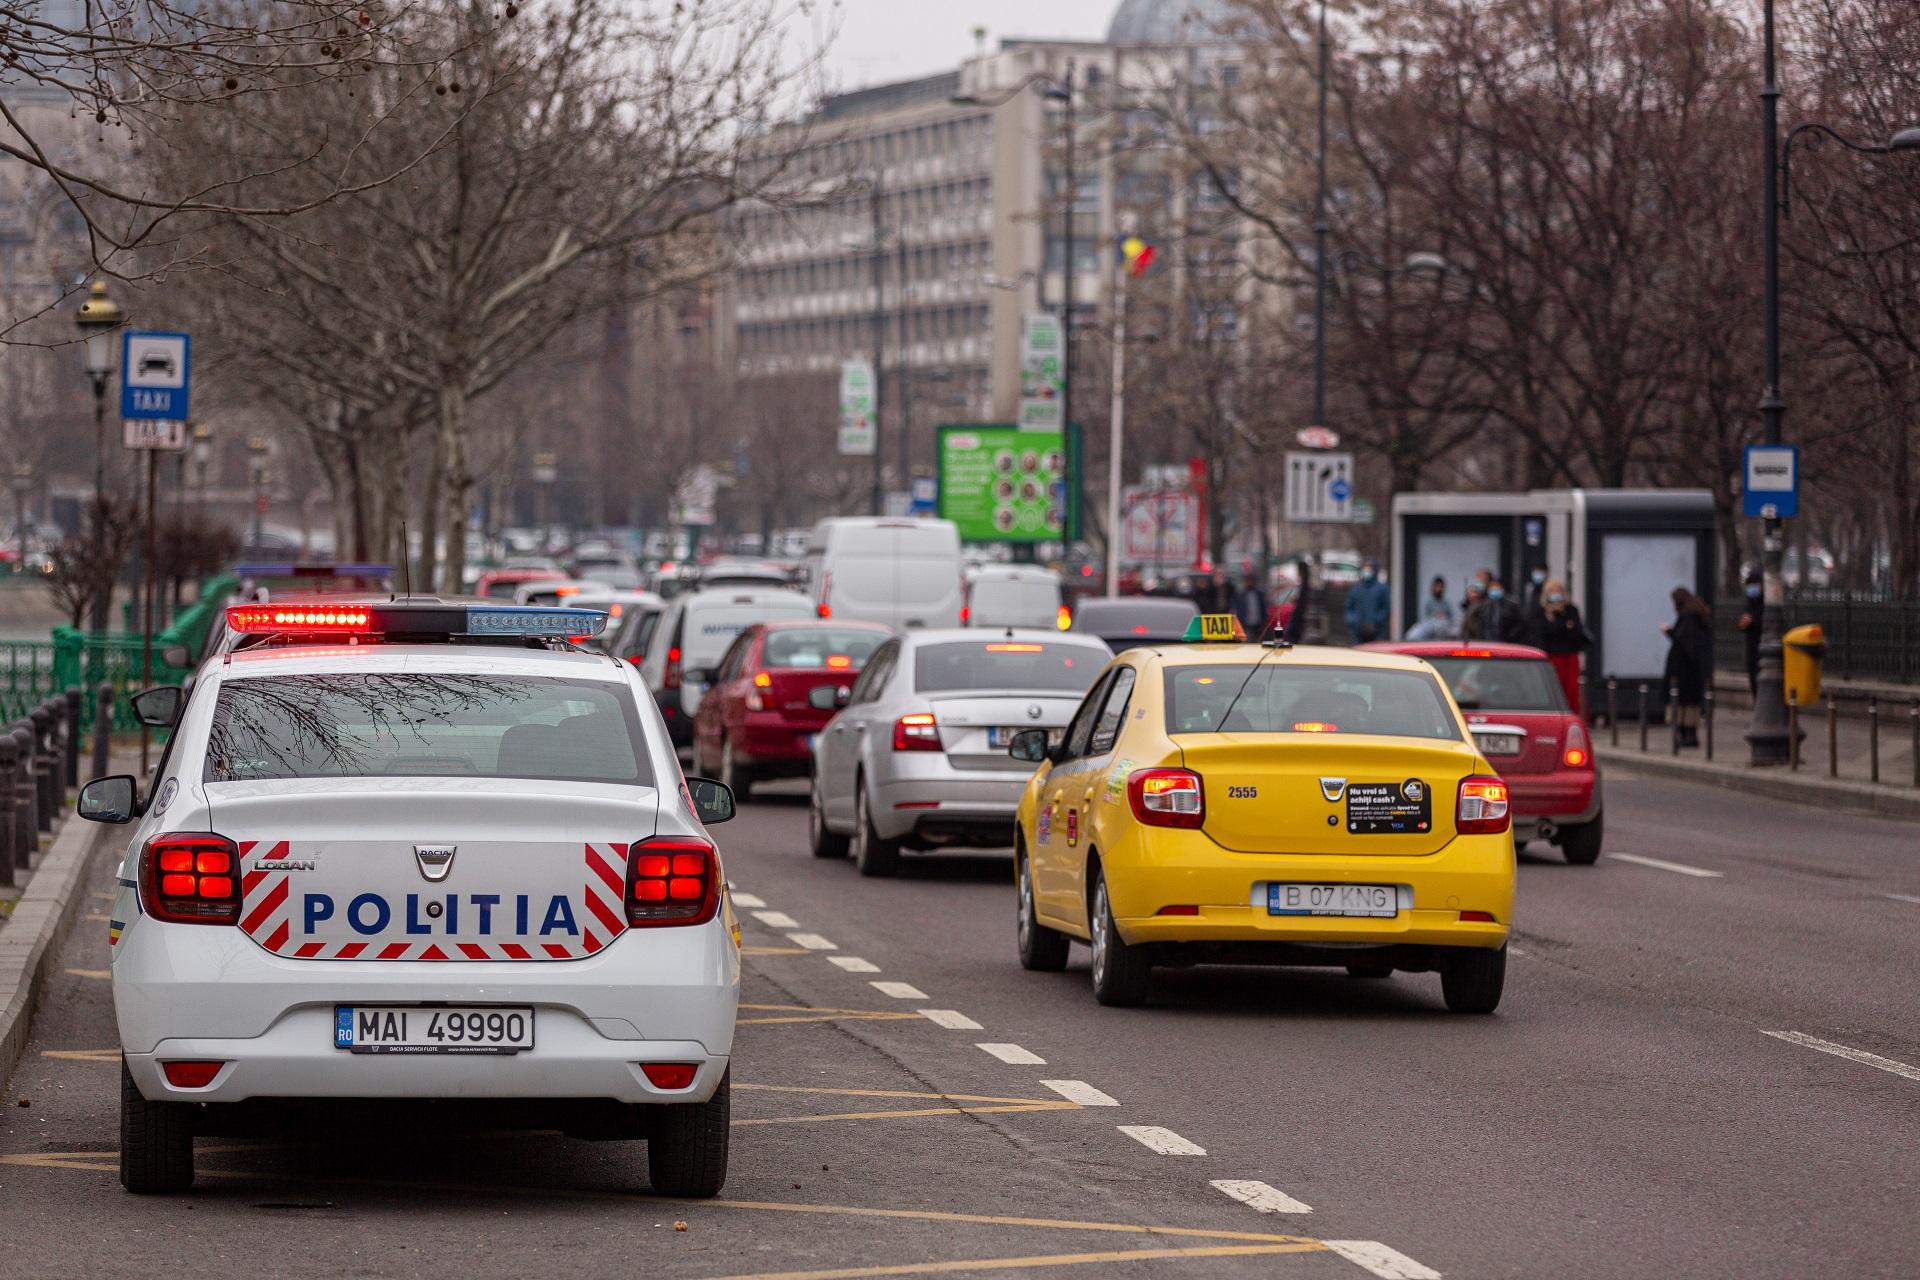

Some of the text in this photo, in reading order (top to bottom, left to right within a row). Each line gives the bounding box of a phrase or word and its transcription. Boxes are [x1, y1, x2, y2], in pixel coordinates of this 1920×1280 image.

[132, 391, 171, 411] TAXI
[1204, 617, 1229, 635] TAXI
[1228, 786, 1257, 798] 2555
[1349, 788, 1361, 796] Nu
[254, 860, 316, 871] LOGAN
[1269, 887, 1386, 908] RO B 07 KNG
[304, 892, 579, 936] POLITIA
[338, 1012, 525, 1043] RO MAI 49990
